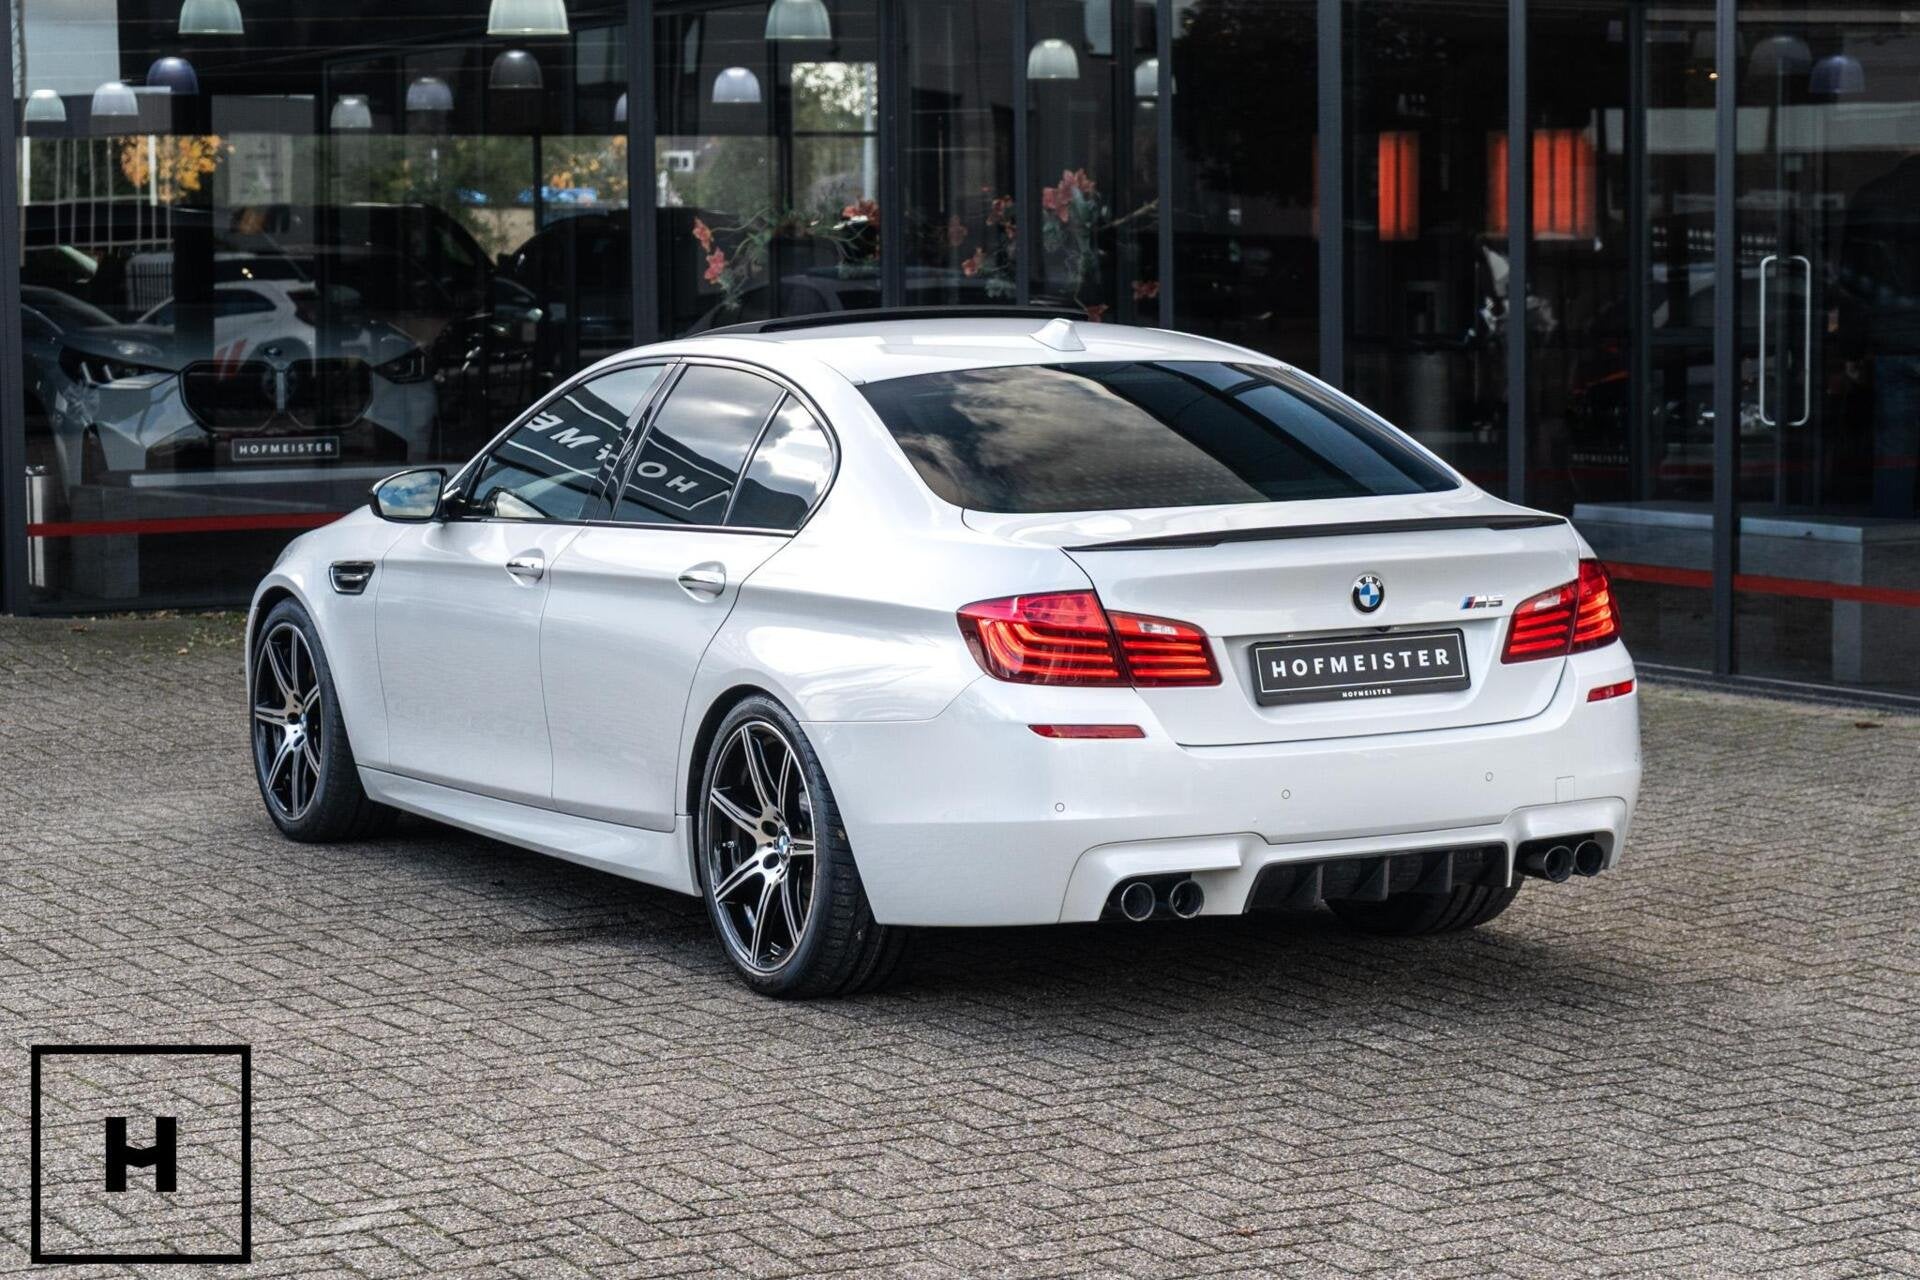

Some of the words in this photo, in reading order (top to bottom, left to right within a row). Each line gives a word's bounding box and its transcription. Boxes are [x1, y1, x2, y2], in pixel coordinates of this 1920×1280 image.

[239, 442, 333, 454] HOFMEISTER
[1272, 648, 1450, 678] HOFMEISTER
[1342, 688, 1392, 699] HOFMEISTER
